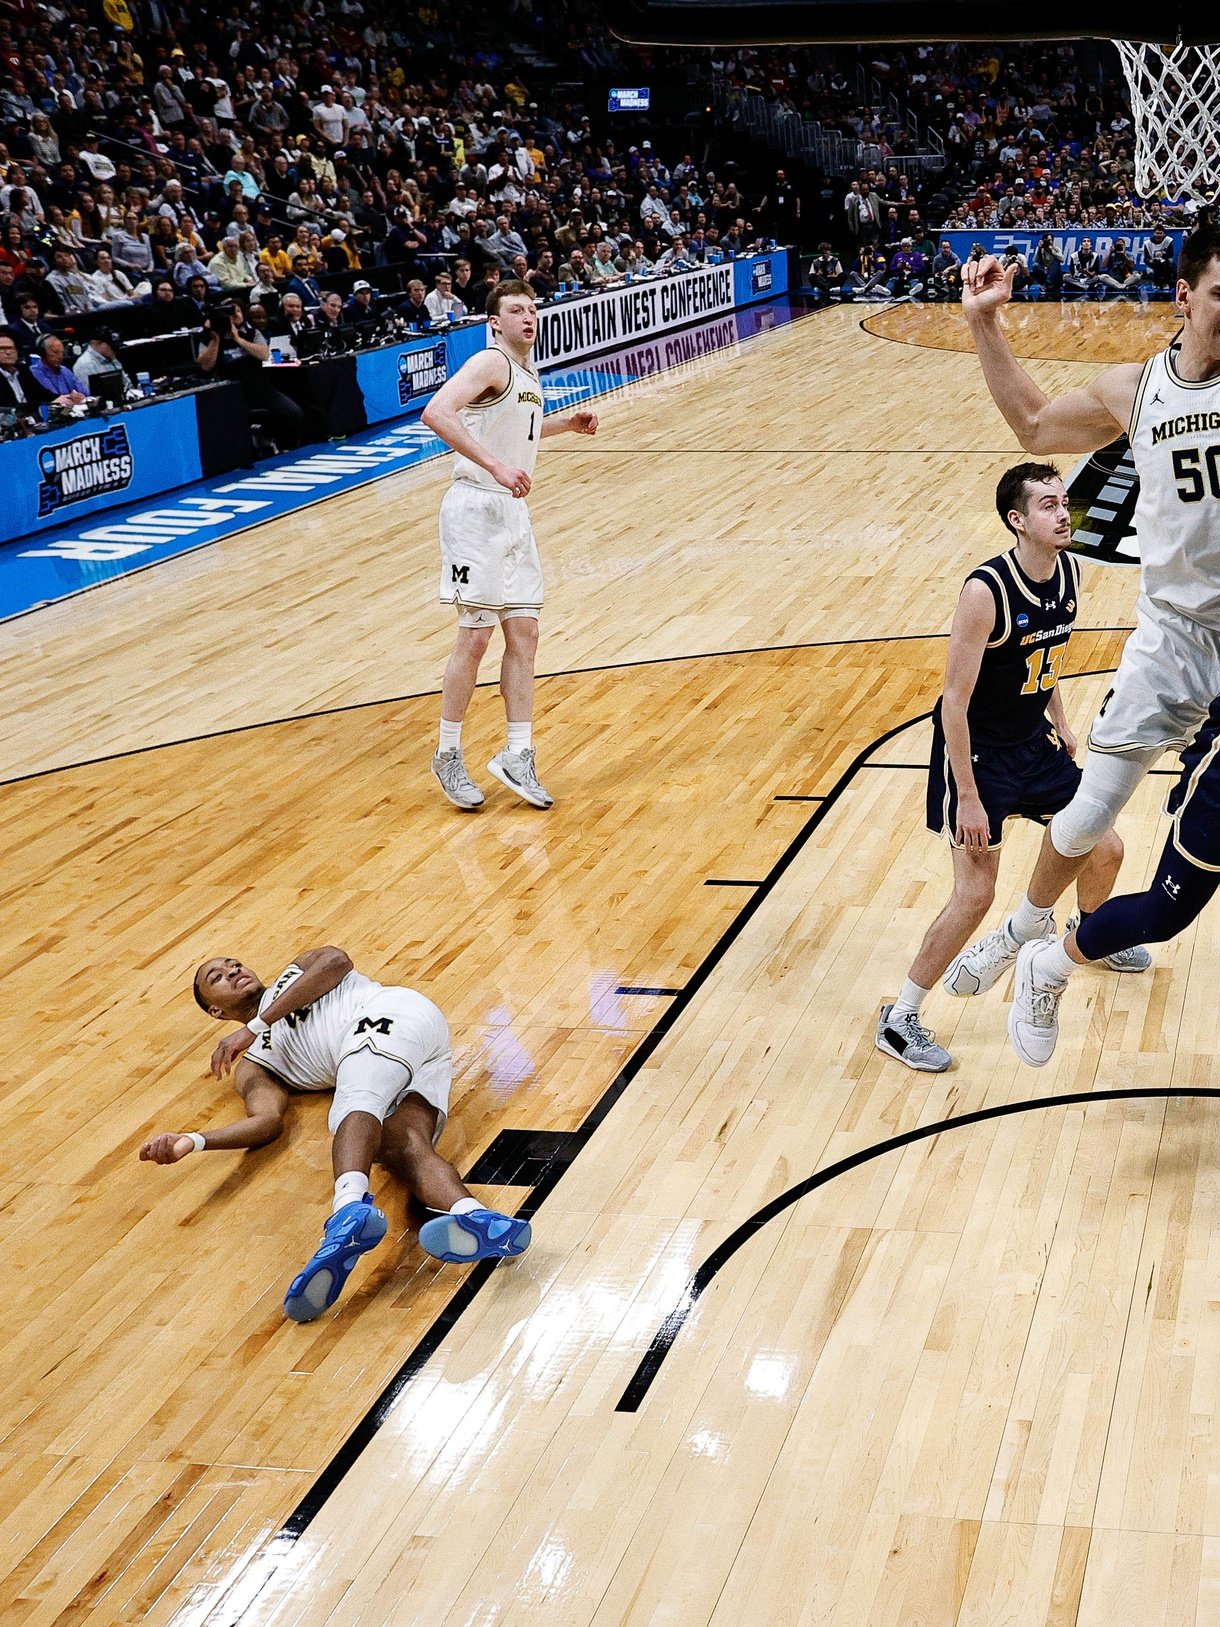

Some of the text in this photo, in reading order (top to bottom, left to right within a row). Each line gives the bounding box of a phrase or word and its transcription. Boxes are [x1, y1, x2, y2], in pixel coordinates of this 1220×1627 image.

[534, 298, 617, 362] MOUNTAIN
[620, 285, 656, 336] WEST
[661, 269, 732, 322] CONFERENCE
[407, 350, 434, 374] MARCH
[412, 365, 447, 391] MADNESS
[527, 411, 535, 441] 1
[55, 437, 102, 473] MARCH
[212, 445, 419, 492] FINAL
[61, 455, 131, 496] MADNESS
[16, 496, 273, 561] FOUR
[451, 564, 470, 584] M
[1020, 641, 1068, 696] 13
[353, 1016, 394, 1036] M
